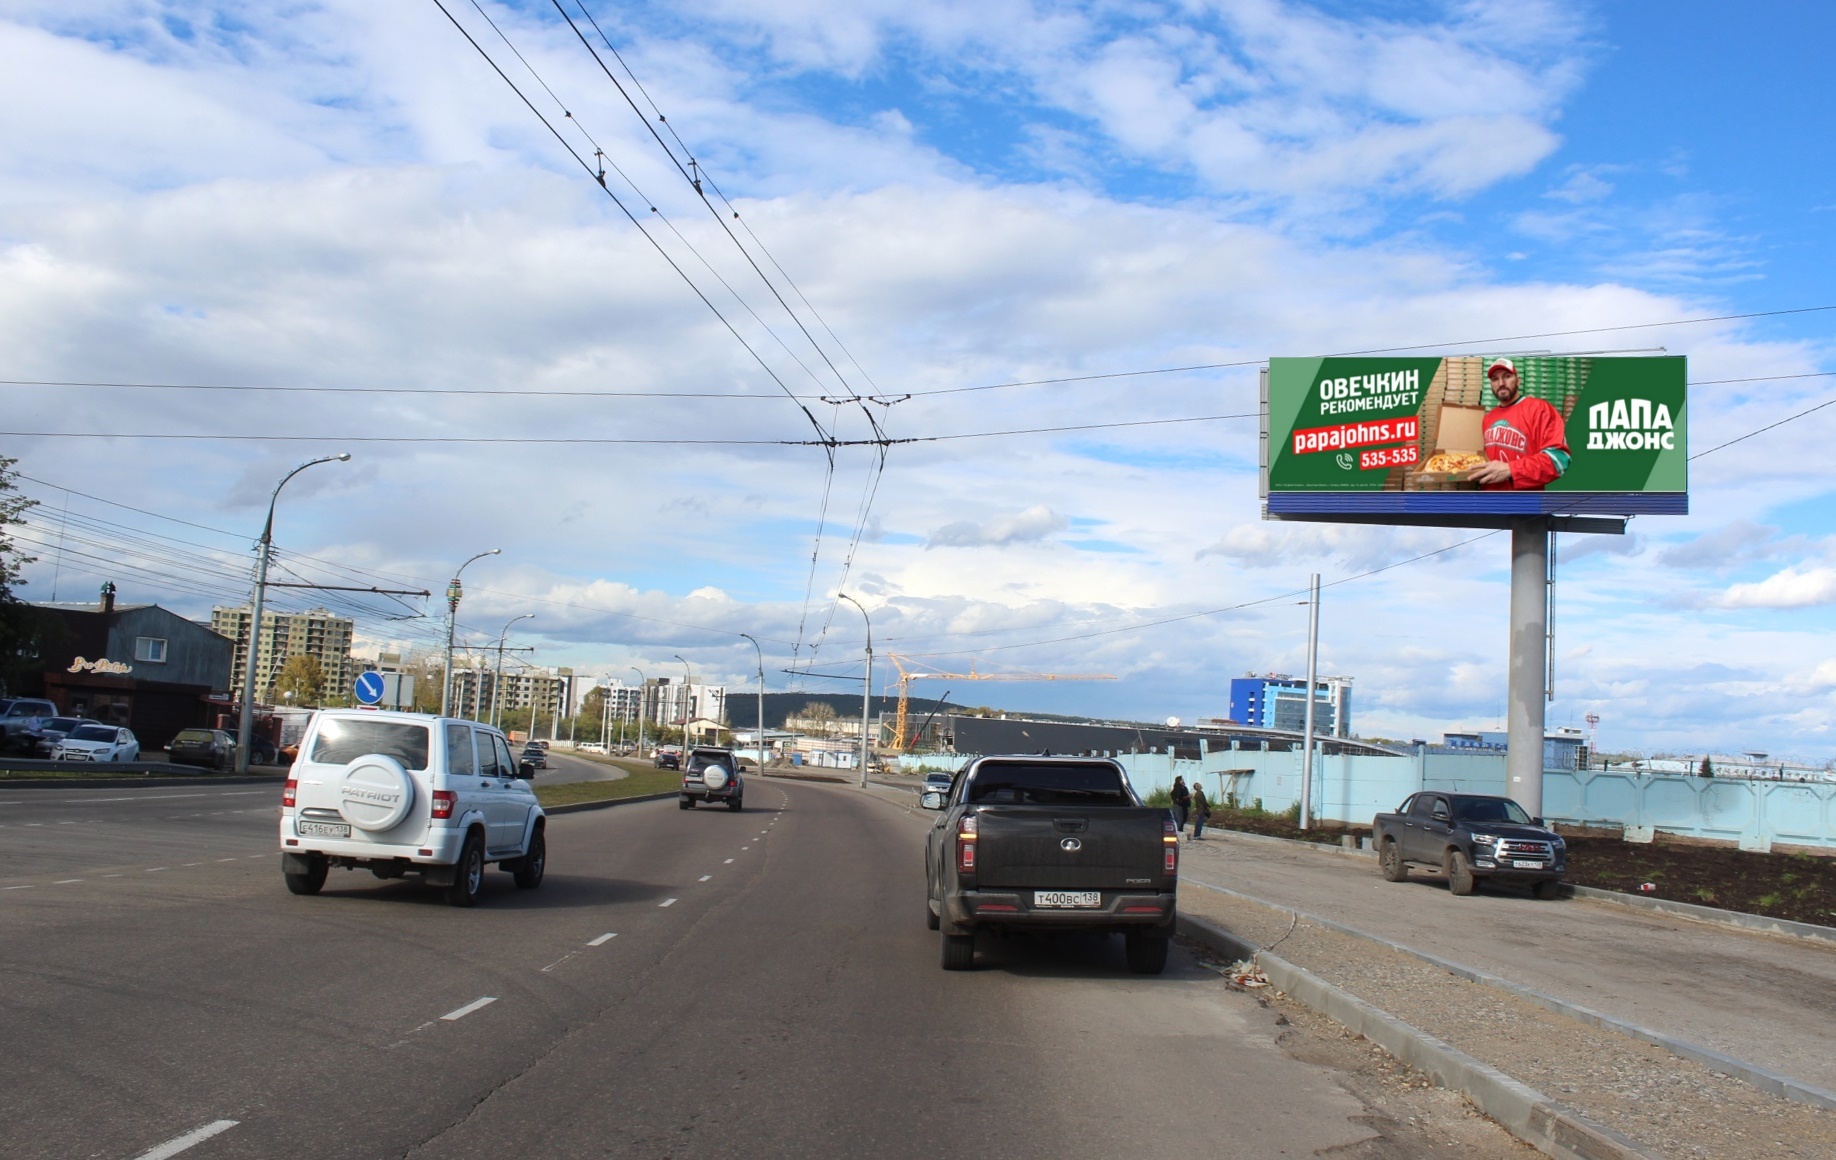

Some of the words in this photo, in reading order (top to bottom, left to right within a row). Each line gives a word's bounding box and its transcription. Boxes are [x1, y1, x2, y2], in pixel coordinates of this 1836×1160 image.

[1320, 369, 1419, 400] ОВЕЧКИН
[1320, 391, 1419, 415] РЕКОМЕНДУЕТ
[1589, 398, 1674, 429] ПАПА
[1295, 421, 1416, 454] papajohns.ru
[1586, 431, 1675, 450] ДЖОНС
[1361, 447, 1417, 467] 535-535
[341, 787, 400, 802] PATRIOT
